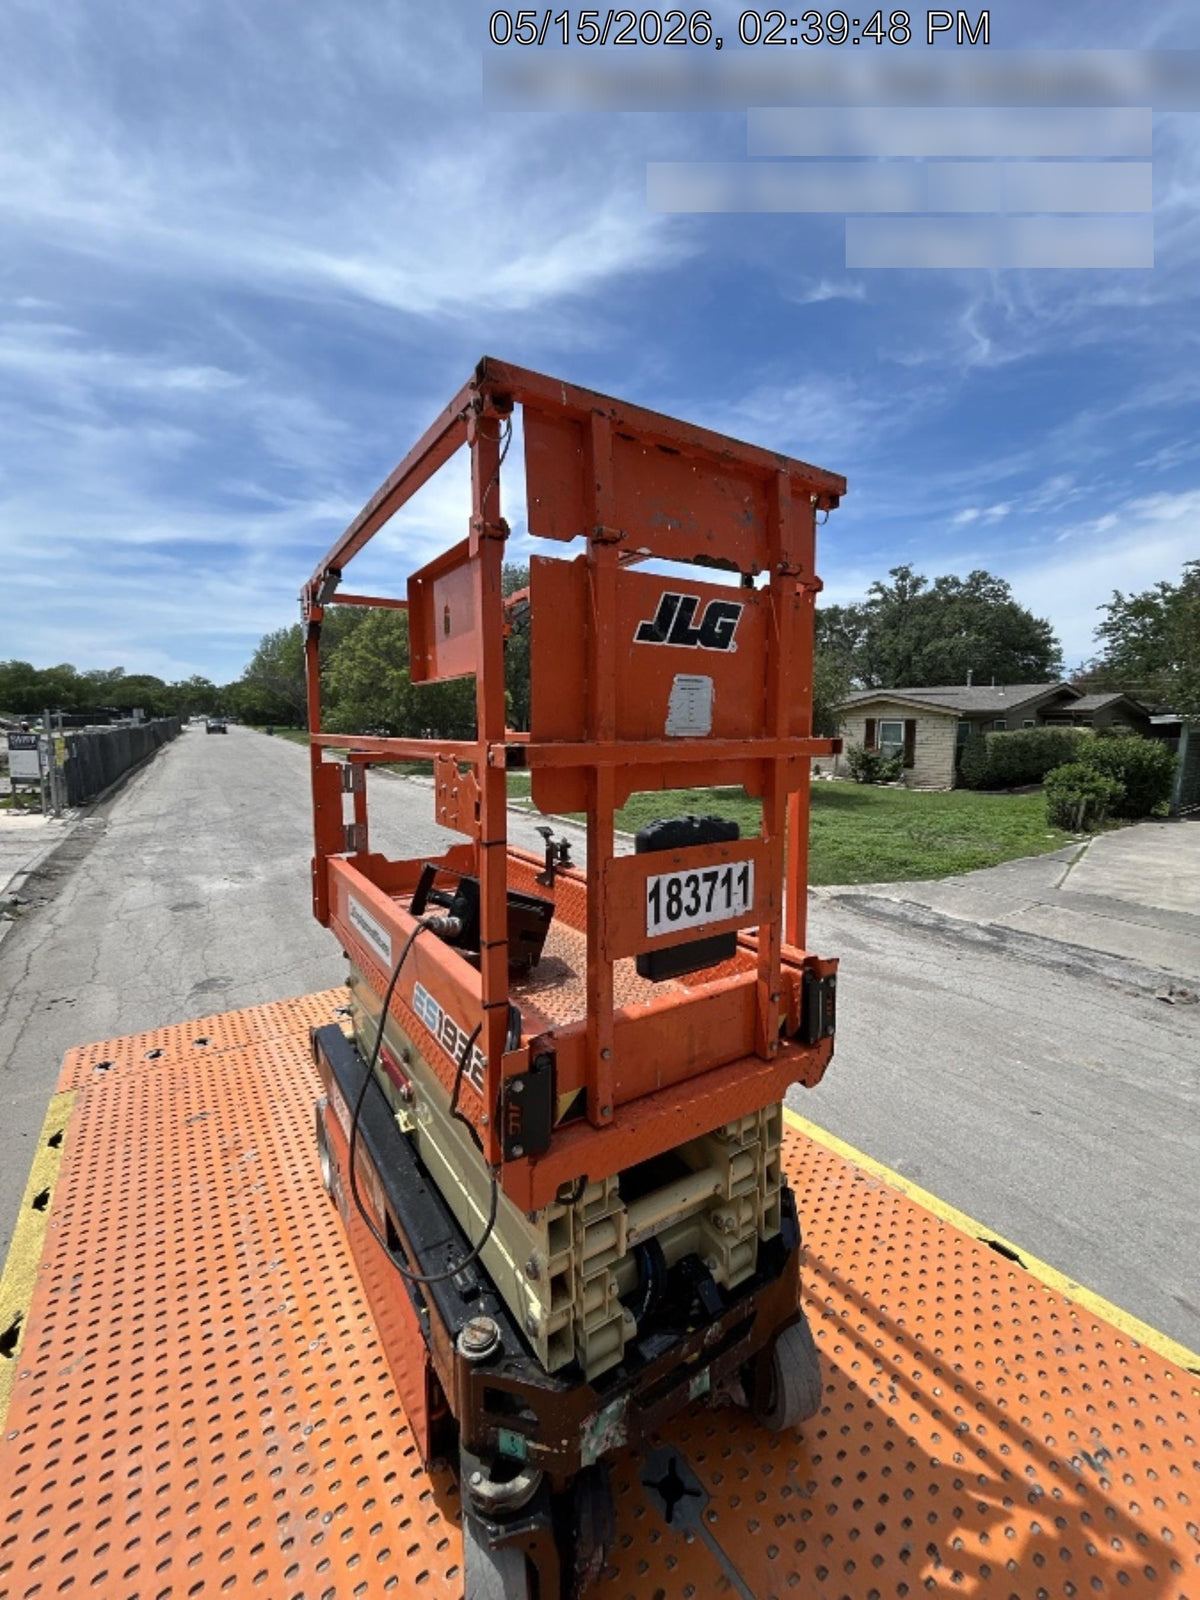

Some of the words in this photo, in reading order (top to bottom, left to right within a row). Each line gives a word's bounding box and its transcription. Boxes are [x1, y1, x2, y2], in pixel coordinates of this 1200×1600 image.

[633, 591, 744, 652] JLG
[648, 865, 750, 925] 183711
[412, 980, 484, 1096] ES1932
